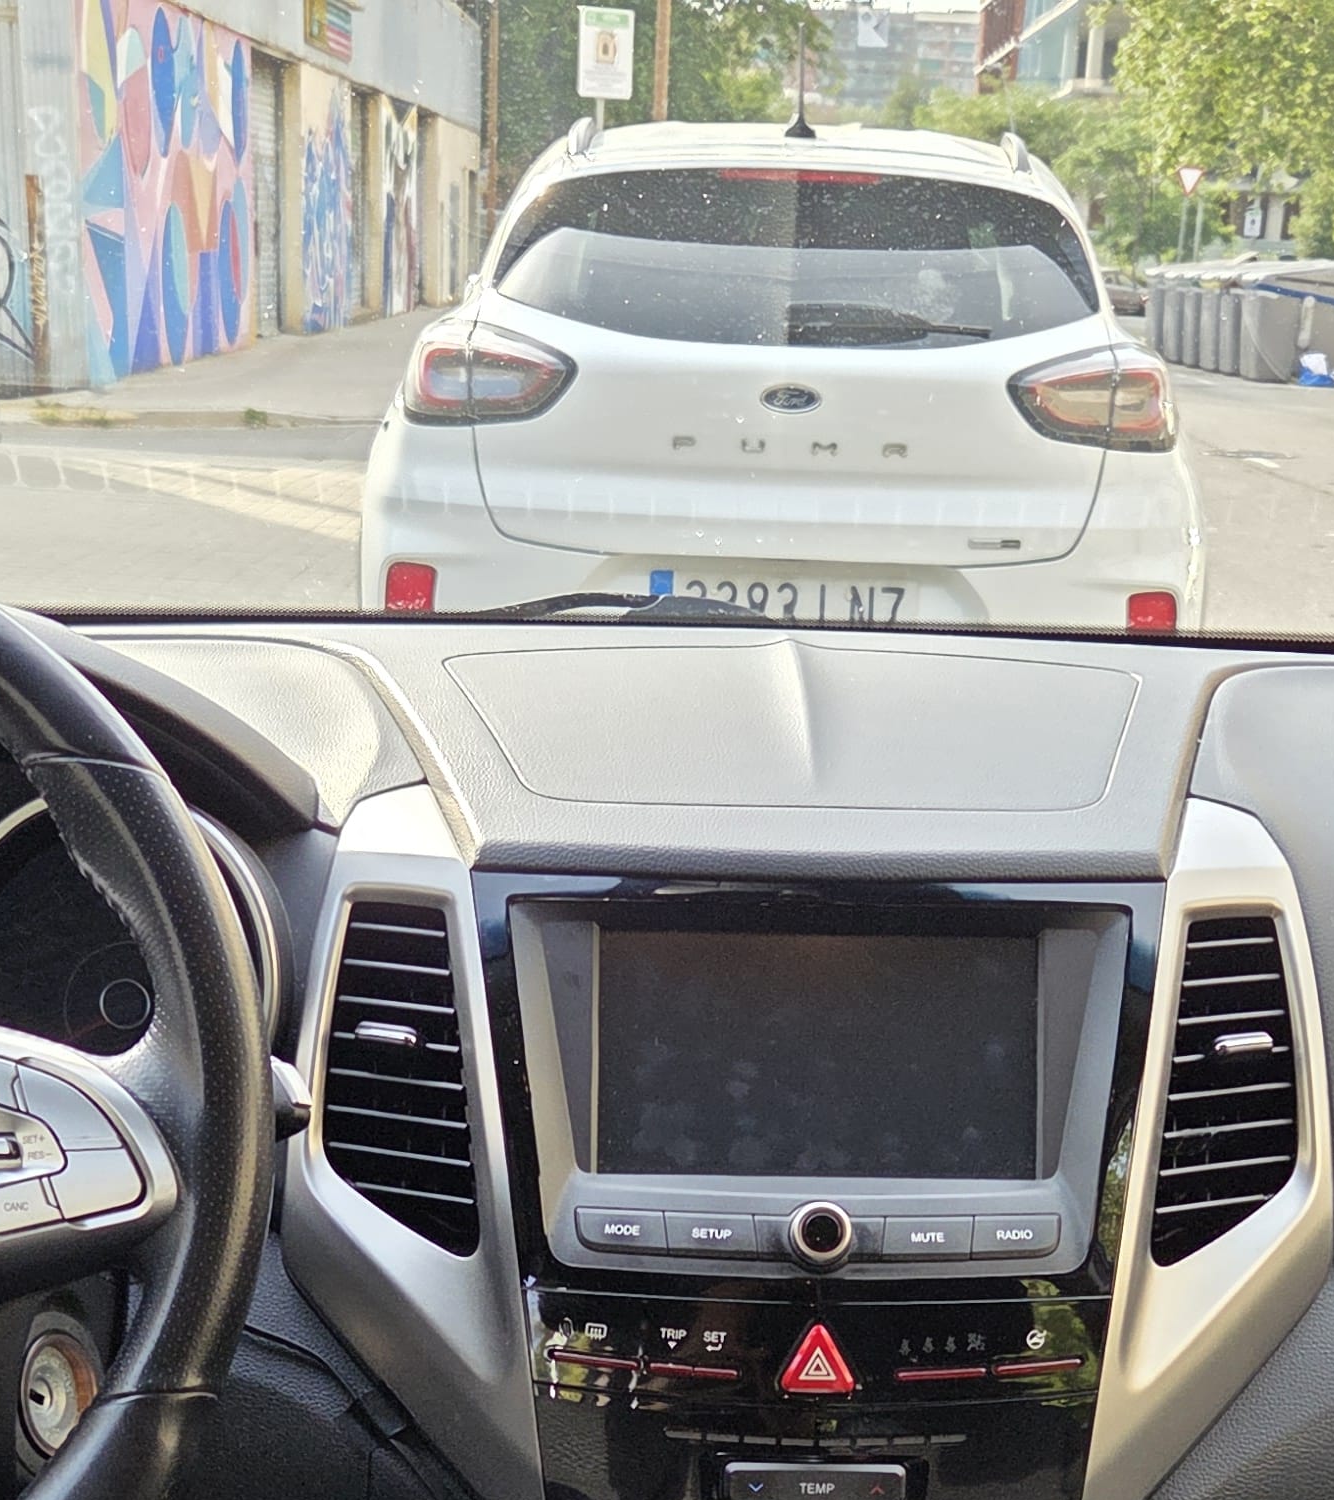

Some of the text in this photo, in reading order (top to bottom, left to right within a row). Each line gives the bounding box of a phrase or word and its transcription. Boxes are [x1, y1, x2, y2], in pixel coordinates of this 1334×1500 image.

[671, 436, 908, 458] PUMA
[3, 1202, 29, 1212] CANC
[604, 1223, 641, 1236] MODE
[690, 1226, 733, 1240] SETUP
[995, 1229, 1034, 1241] RADIO
[910, 1231, 946, 1243] MUTE
[659, 1326, 687, 1340] TRIP
[703, 1330, 727, 1344] SET
[799, 1482, 836, 1495] TEMP
